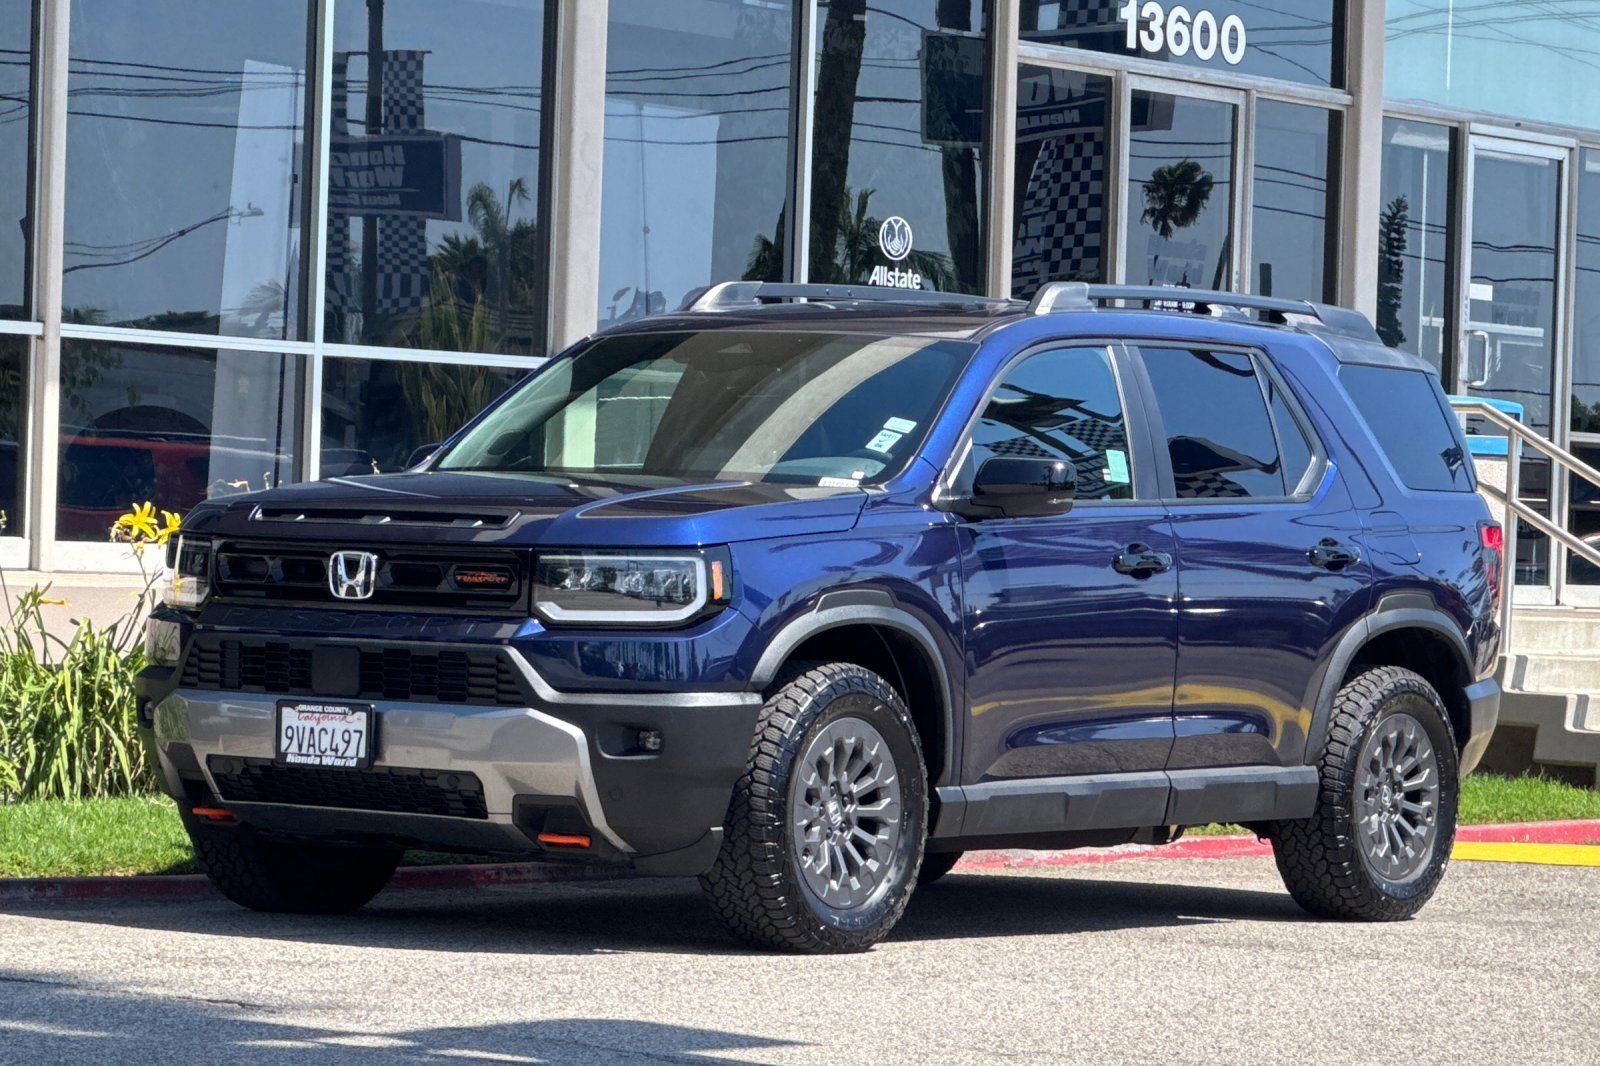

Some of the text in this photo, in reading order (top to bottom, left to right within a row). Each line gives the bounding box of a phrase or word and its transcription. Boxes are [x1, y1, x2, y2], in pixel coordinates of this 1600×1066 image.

[1120, 0, 1246, 65] 13600
[868, 265, 921, 289] Allstate
[297, 711, 351, 726] California
[298, 704, 349, 714] ORANGE COUNTY
[284, 725, 363, 757] 9VAC497
[286, 753, 358, 767] Honda World
